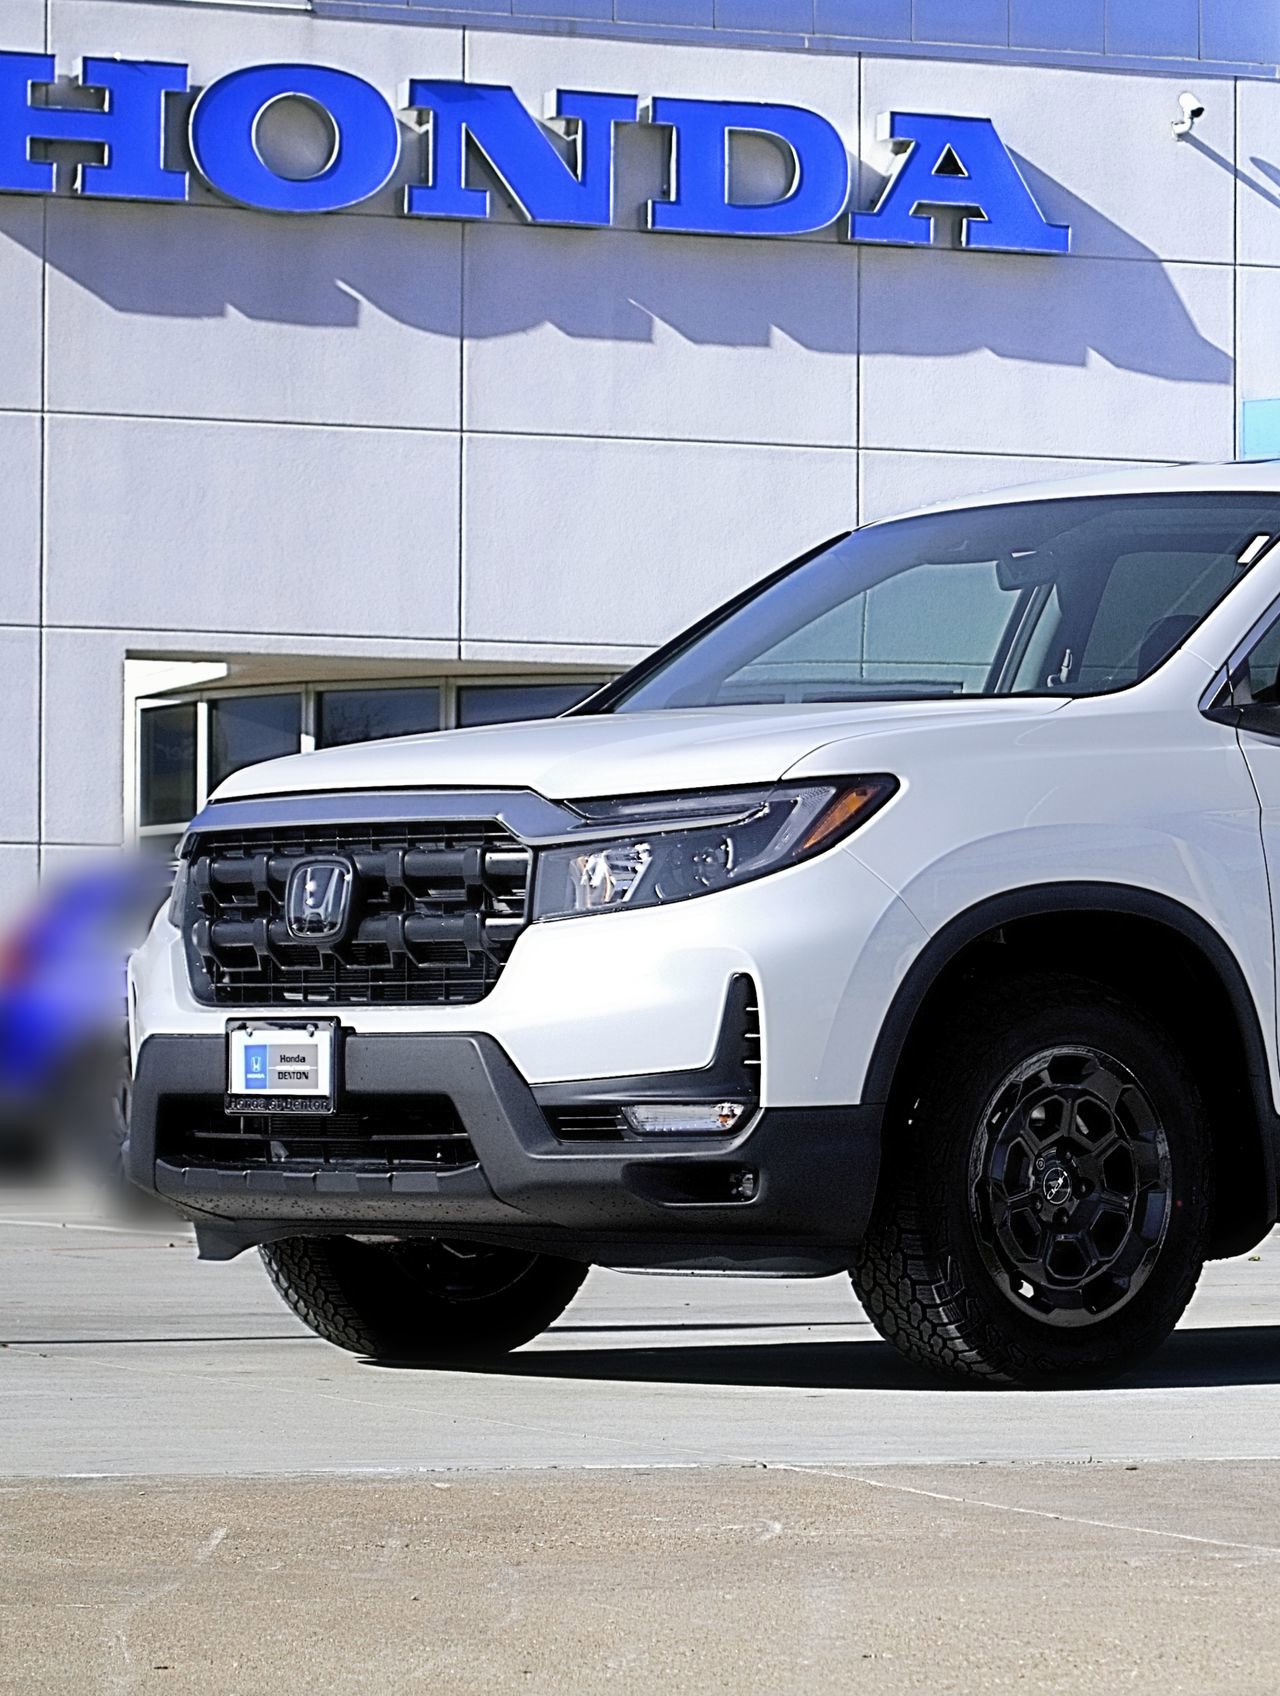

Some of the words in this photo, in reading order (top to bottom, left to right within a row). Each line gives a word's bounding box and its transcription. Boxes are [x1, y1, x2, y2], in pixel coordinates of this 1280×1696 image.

[0, 51, 1071, 254] HONDA
[279, 1054, 306, 1063] Honda
[277, 1071, 309, 1080] DENTON
